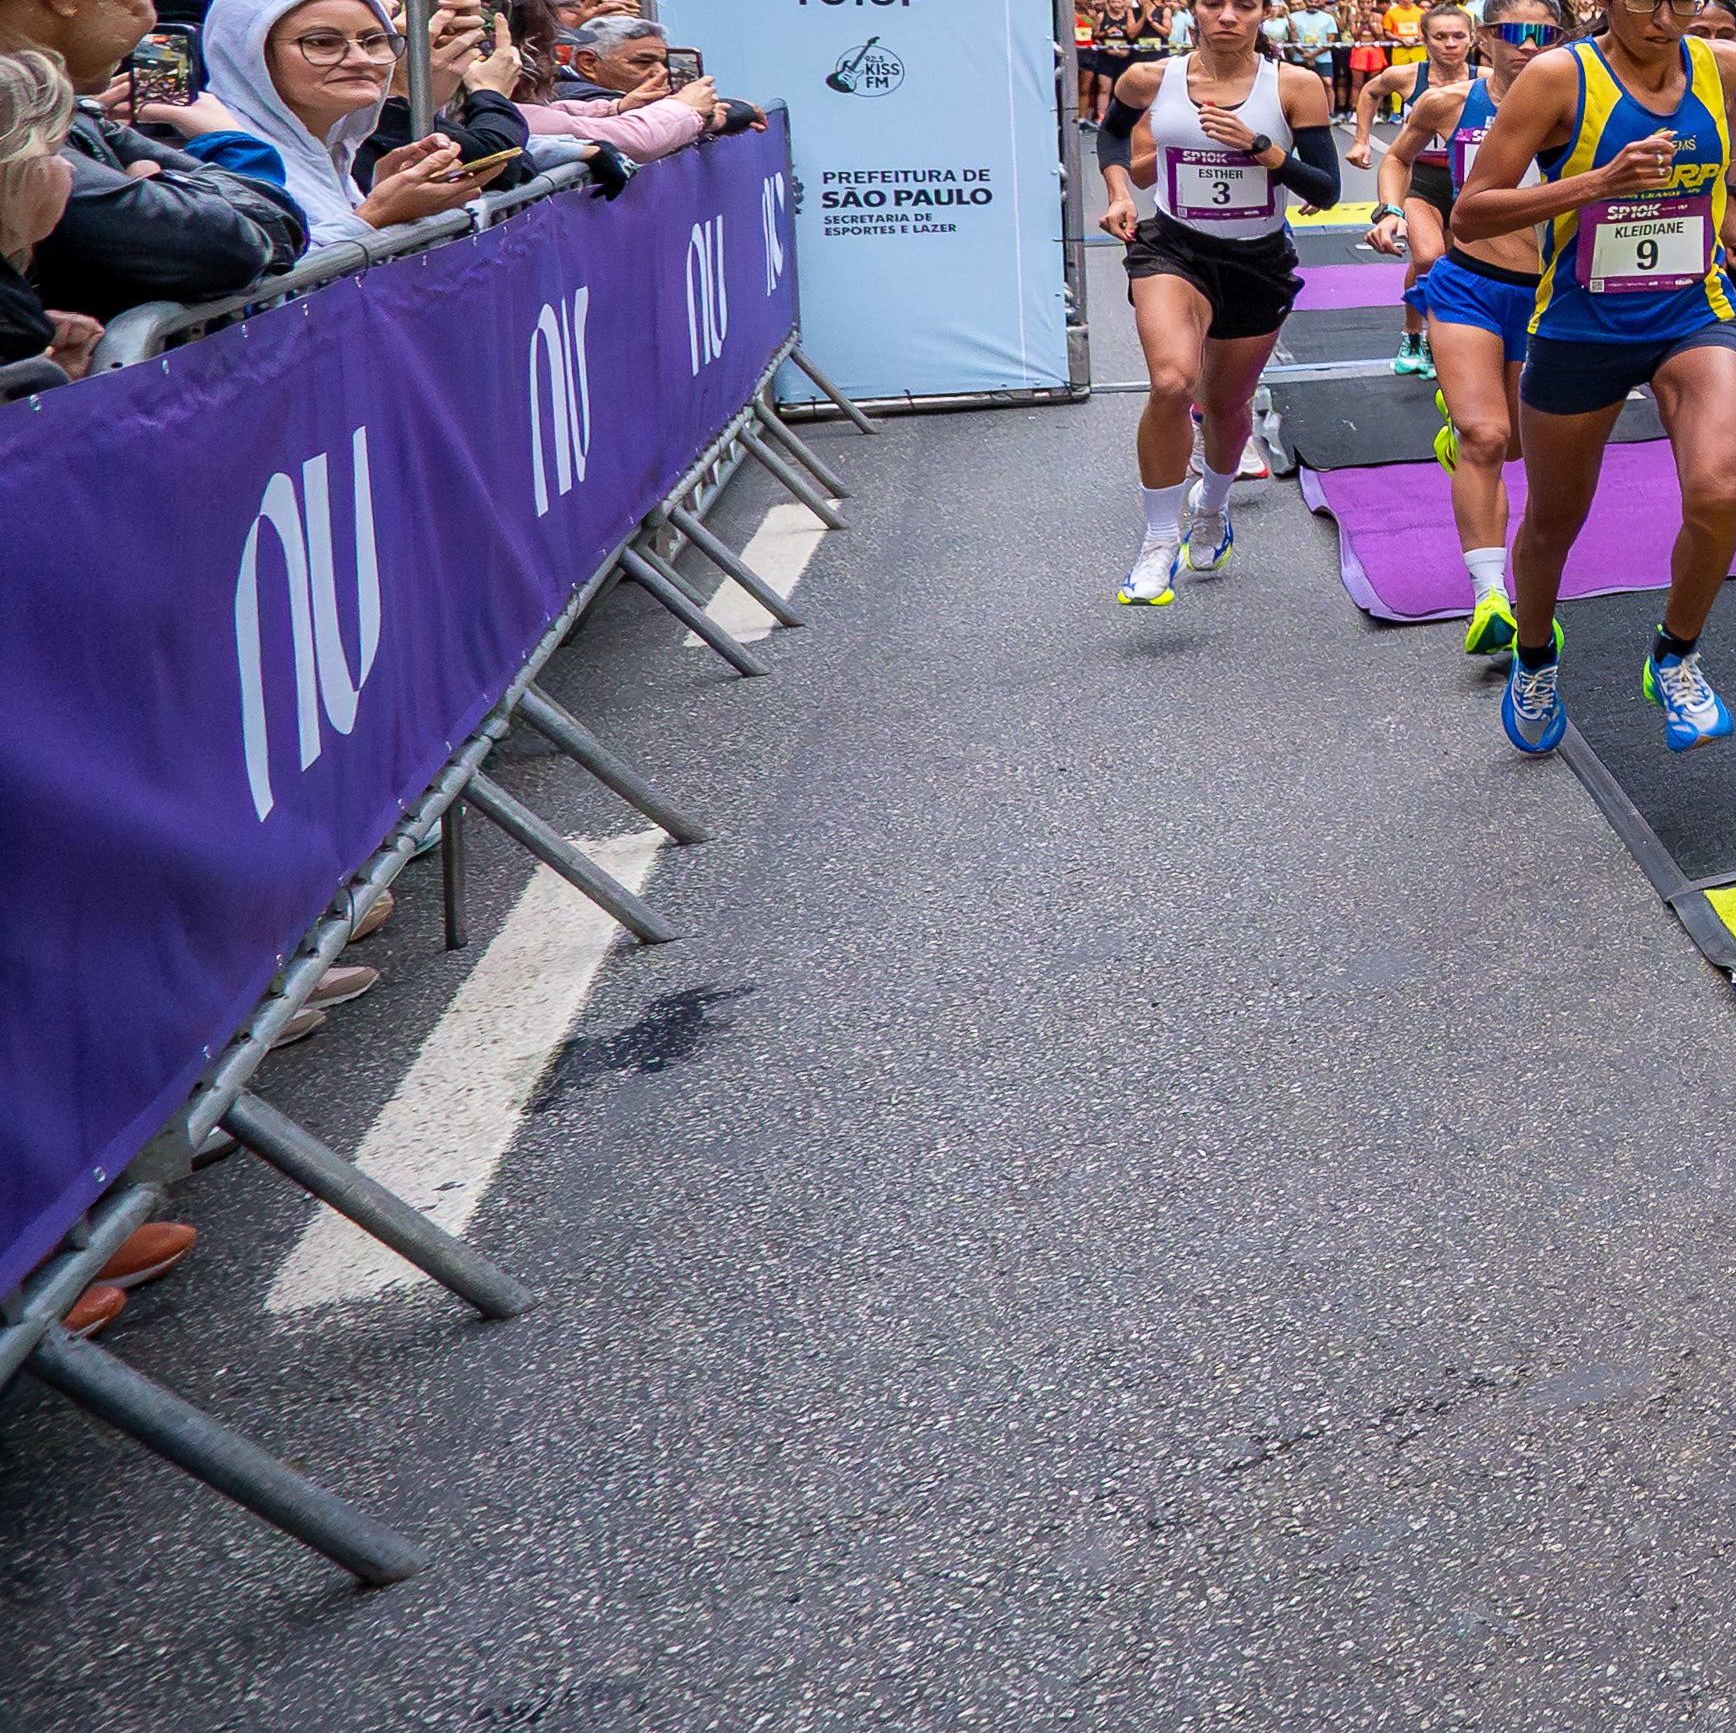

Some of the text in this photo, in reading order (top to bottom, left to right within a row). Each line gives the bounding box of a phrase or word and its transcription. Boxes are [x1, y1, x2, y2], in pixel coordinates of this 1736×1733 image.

[863, 55, 885, 64] 92.5
[865, 62, 900, 76] KISS
[866, 76, 889, 89] FM
[823, 168, 991, 185] PREFEITURA DE
[1198, 168, 1244, 180] ESTHER
[821, 186, 993, 209] SÃO PAULO
[1211, 181, 1231, 205] 3
[823, 212, 933, 225] SECRETARIA DE
[1606, 203, 1661, 220] SP10K
[824, 223, 957, 236] ESPORTES E LAZER
[1615, 221, 1684, 239] KLEIDIANE
[1636, 239, 1659, 270] 9
